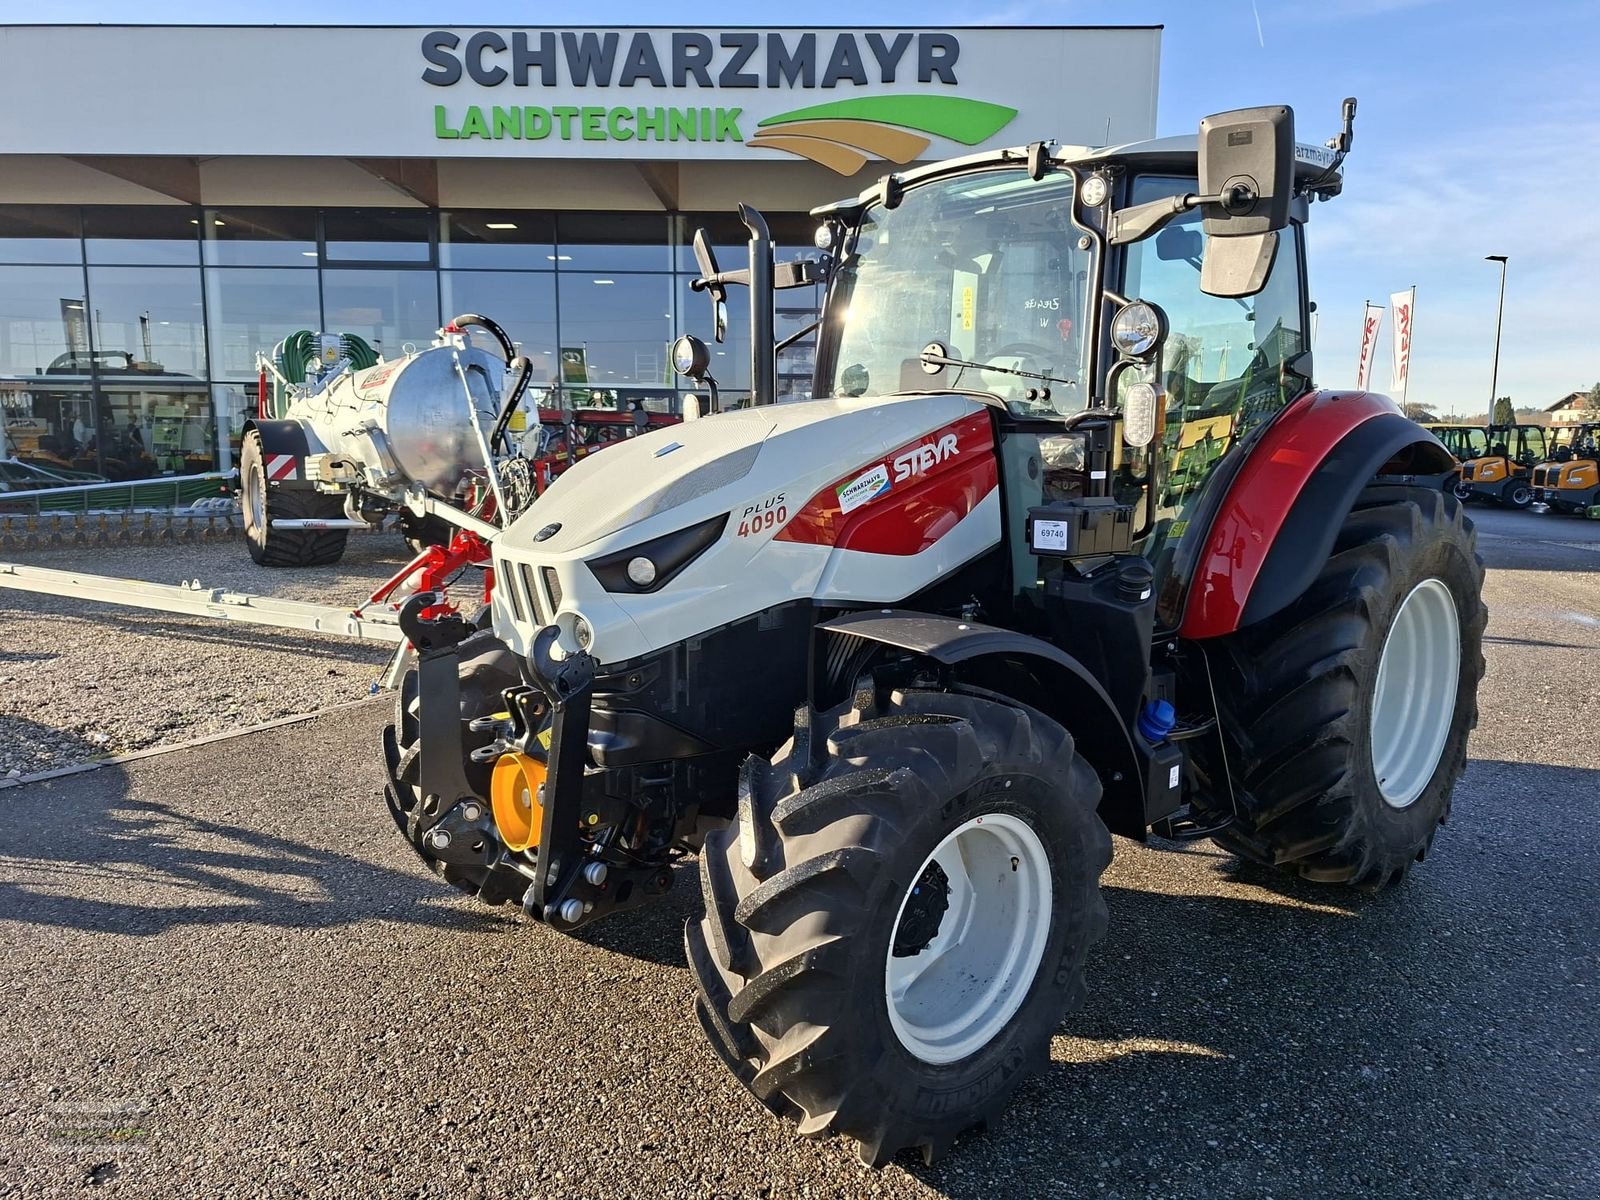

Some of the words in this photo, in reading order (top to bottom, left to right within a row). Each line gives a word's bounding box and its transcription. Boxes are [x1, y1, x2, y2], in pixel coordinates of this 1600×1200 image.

[421, 31, 960, 88] SCHWARZMAYR
[434, 105, 744, 143] LANDTECHNIK
[894, 433, 960, 484] STEYR
[737, 505, 787, 538] 4090
[743, 492, 786, 518] PLUS
[1040, 528, 1064, 538] 69740
